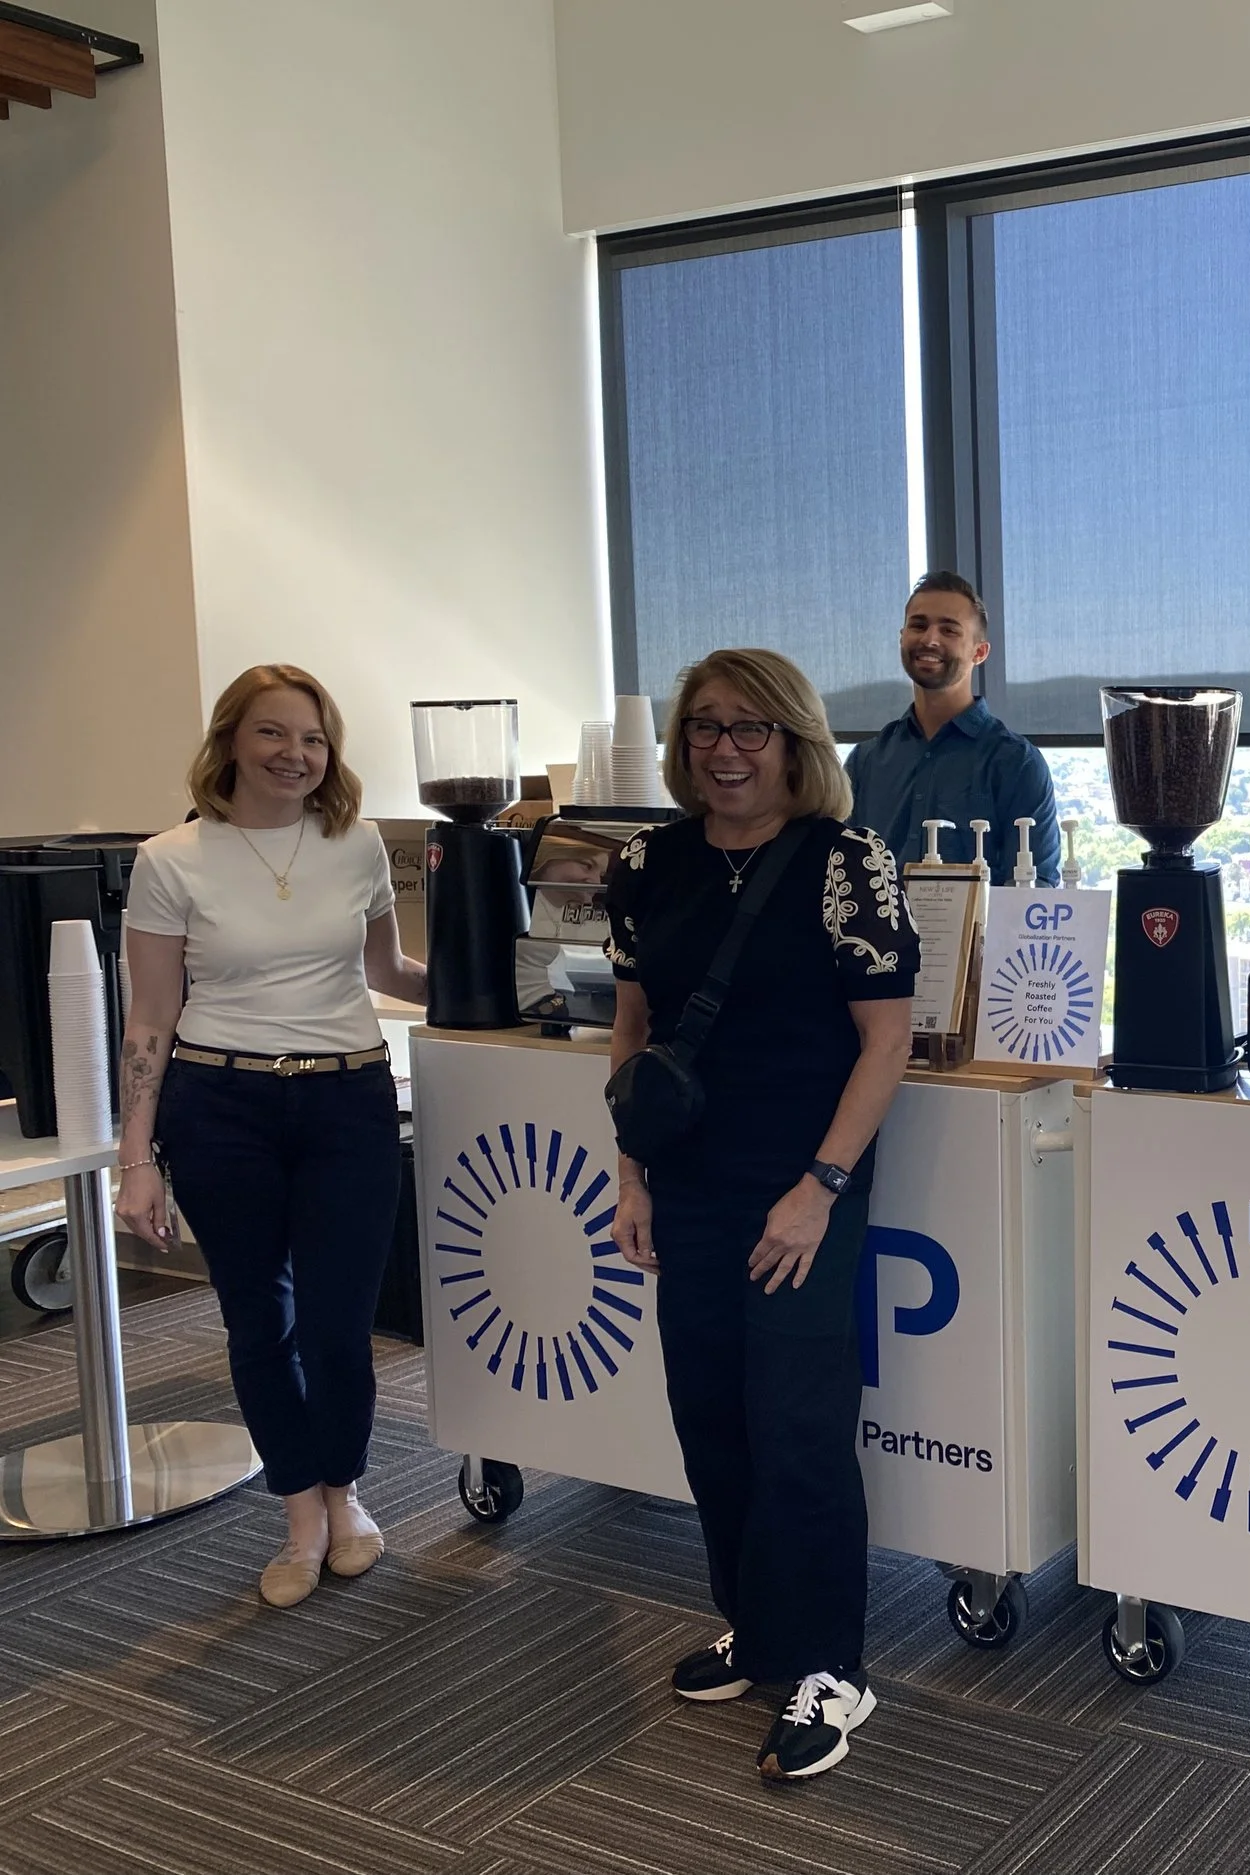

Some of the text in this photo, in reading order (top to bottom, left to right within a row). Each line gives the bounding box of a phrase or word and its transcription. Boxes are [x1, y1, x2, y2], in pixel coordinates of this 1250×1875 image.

[391, 879, 418, 893] aper
[1146, 911, 1174, 920] EUREKA
[1018, 933, 1076, 942] Globalization Partners
[1028, 980, 1056, 991] Freshly
[1025, 992, 1056, 1001] Roasted
[1027, 1004, 1053, 1012] Coffee
[1024, 1015, 1053, 1025] For You
[856, 1224, 960, 1388] P
[862, 1419, 993, 1472] Partners
